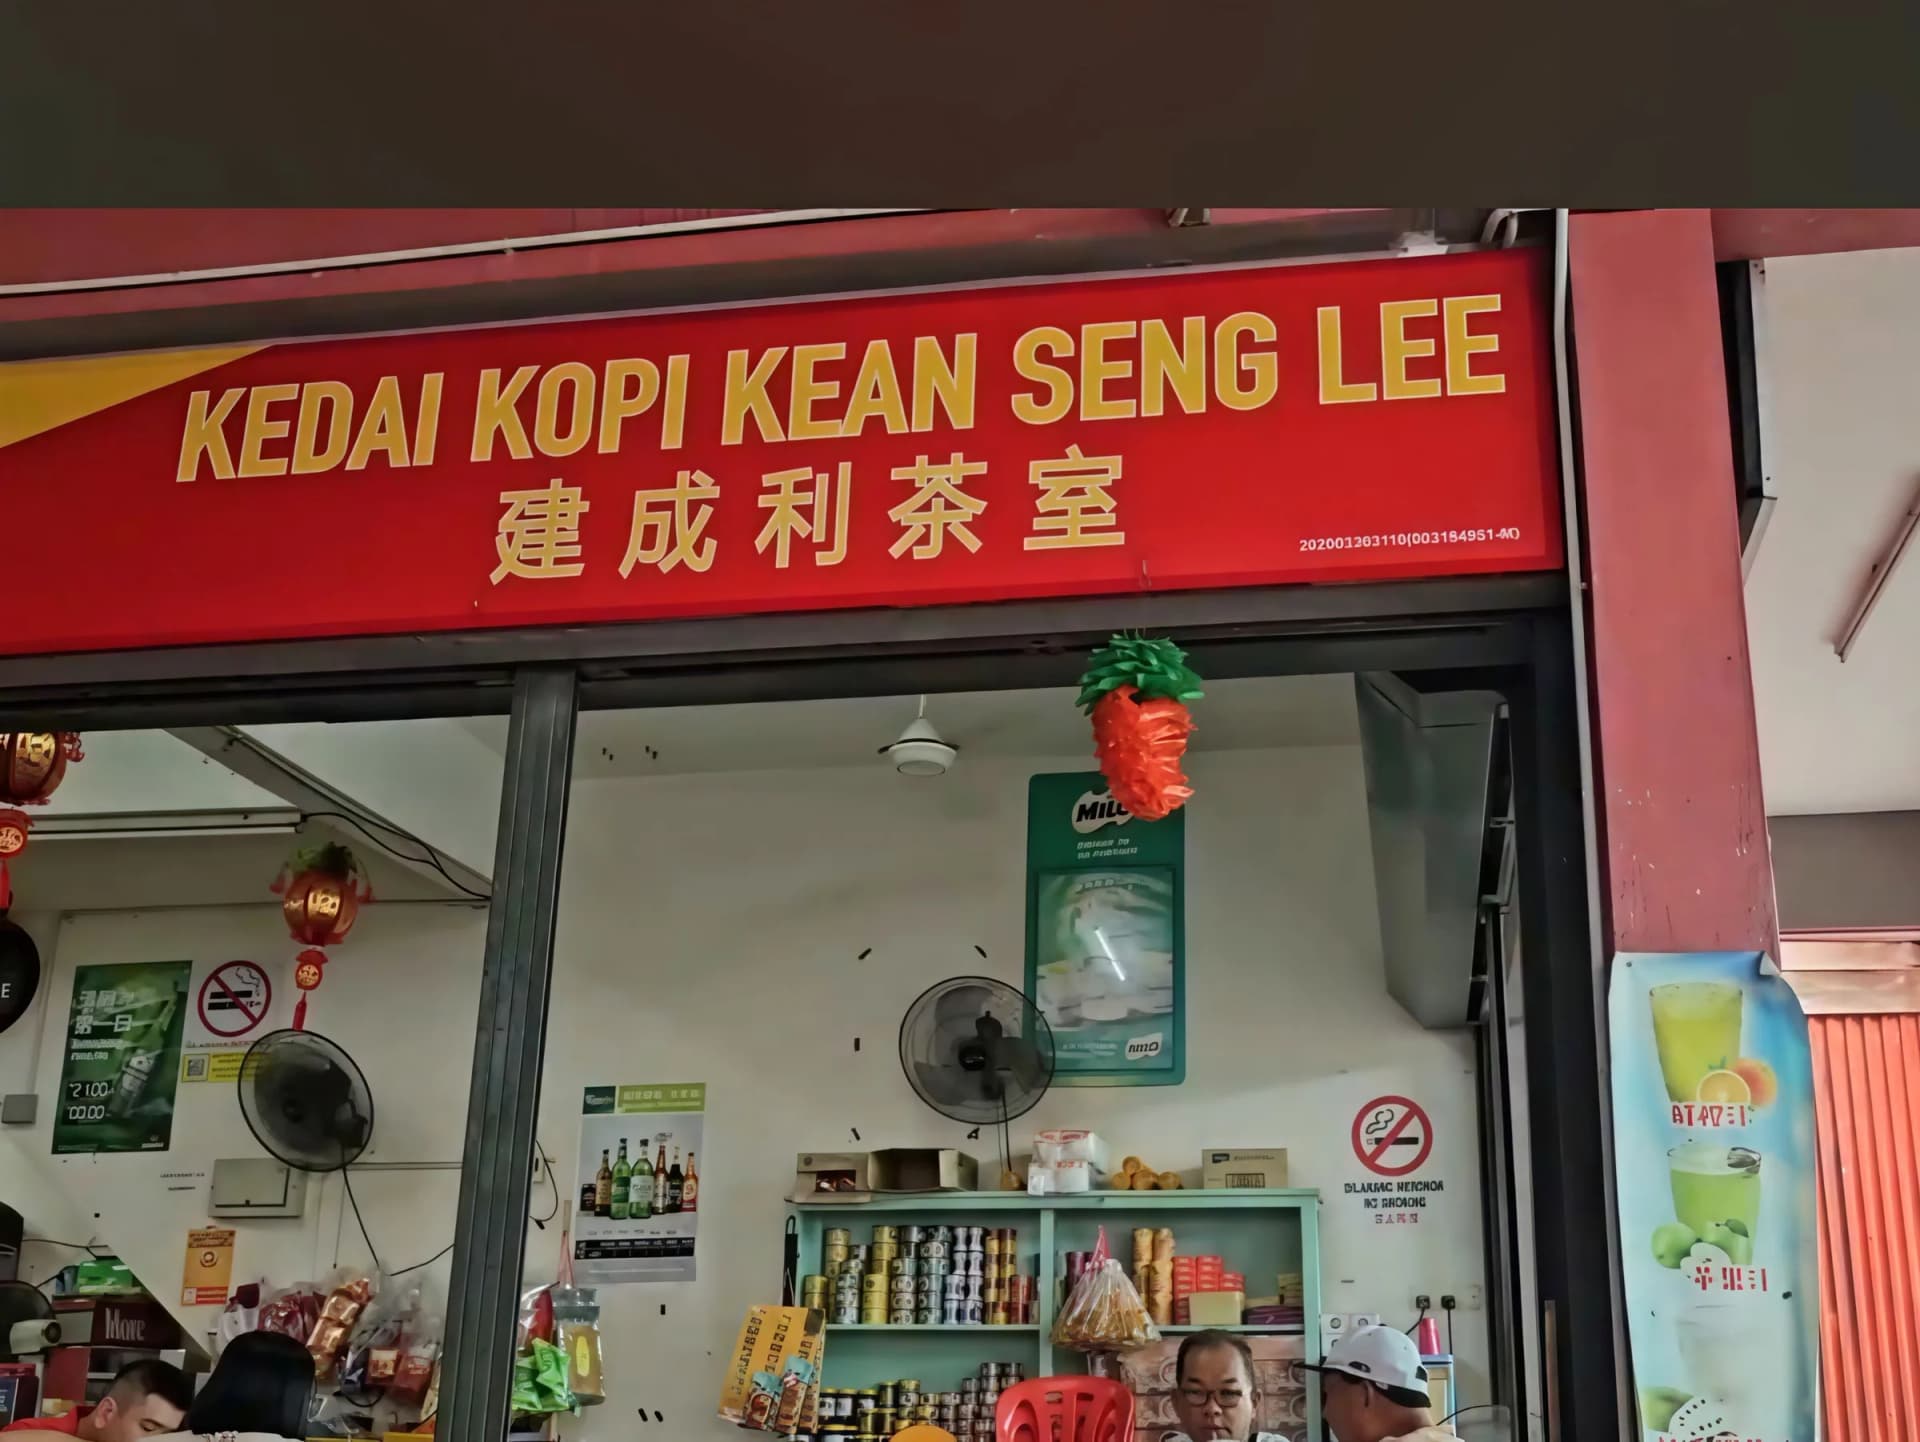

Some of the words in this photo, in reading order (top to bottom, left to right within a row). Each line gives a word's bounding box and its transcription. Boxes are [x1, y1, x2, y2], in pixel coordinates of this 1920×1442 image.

[176, 372, 445, 483] KEDAI
[470, 354, 691, 463] KOPI
[721, 333, 978, 446] KEAN
[1011, 311, 1279, 426] SENG
[1316, 294, 1507, 405] LEE
[489, 444, 1126, 586] 建成利茶室
